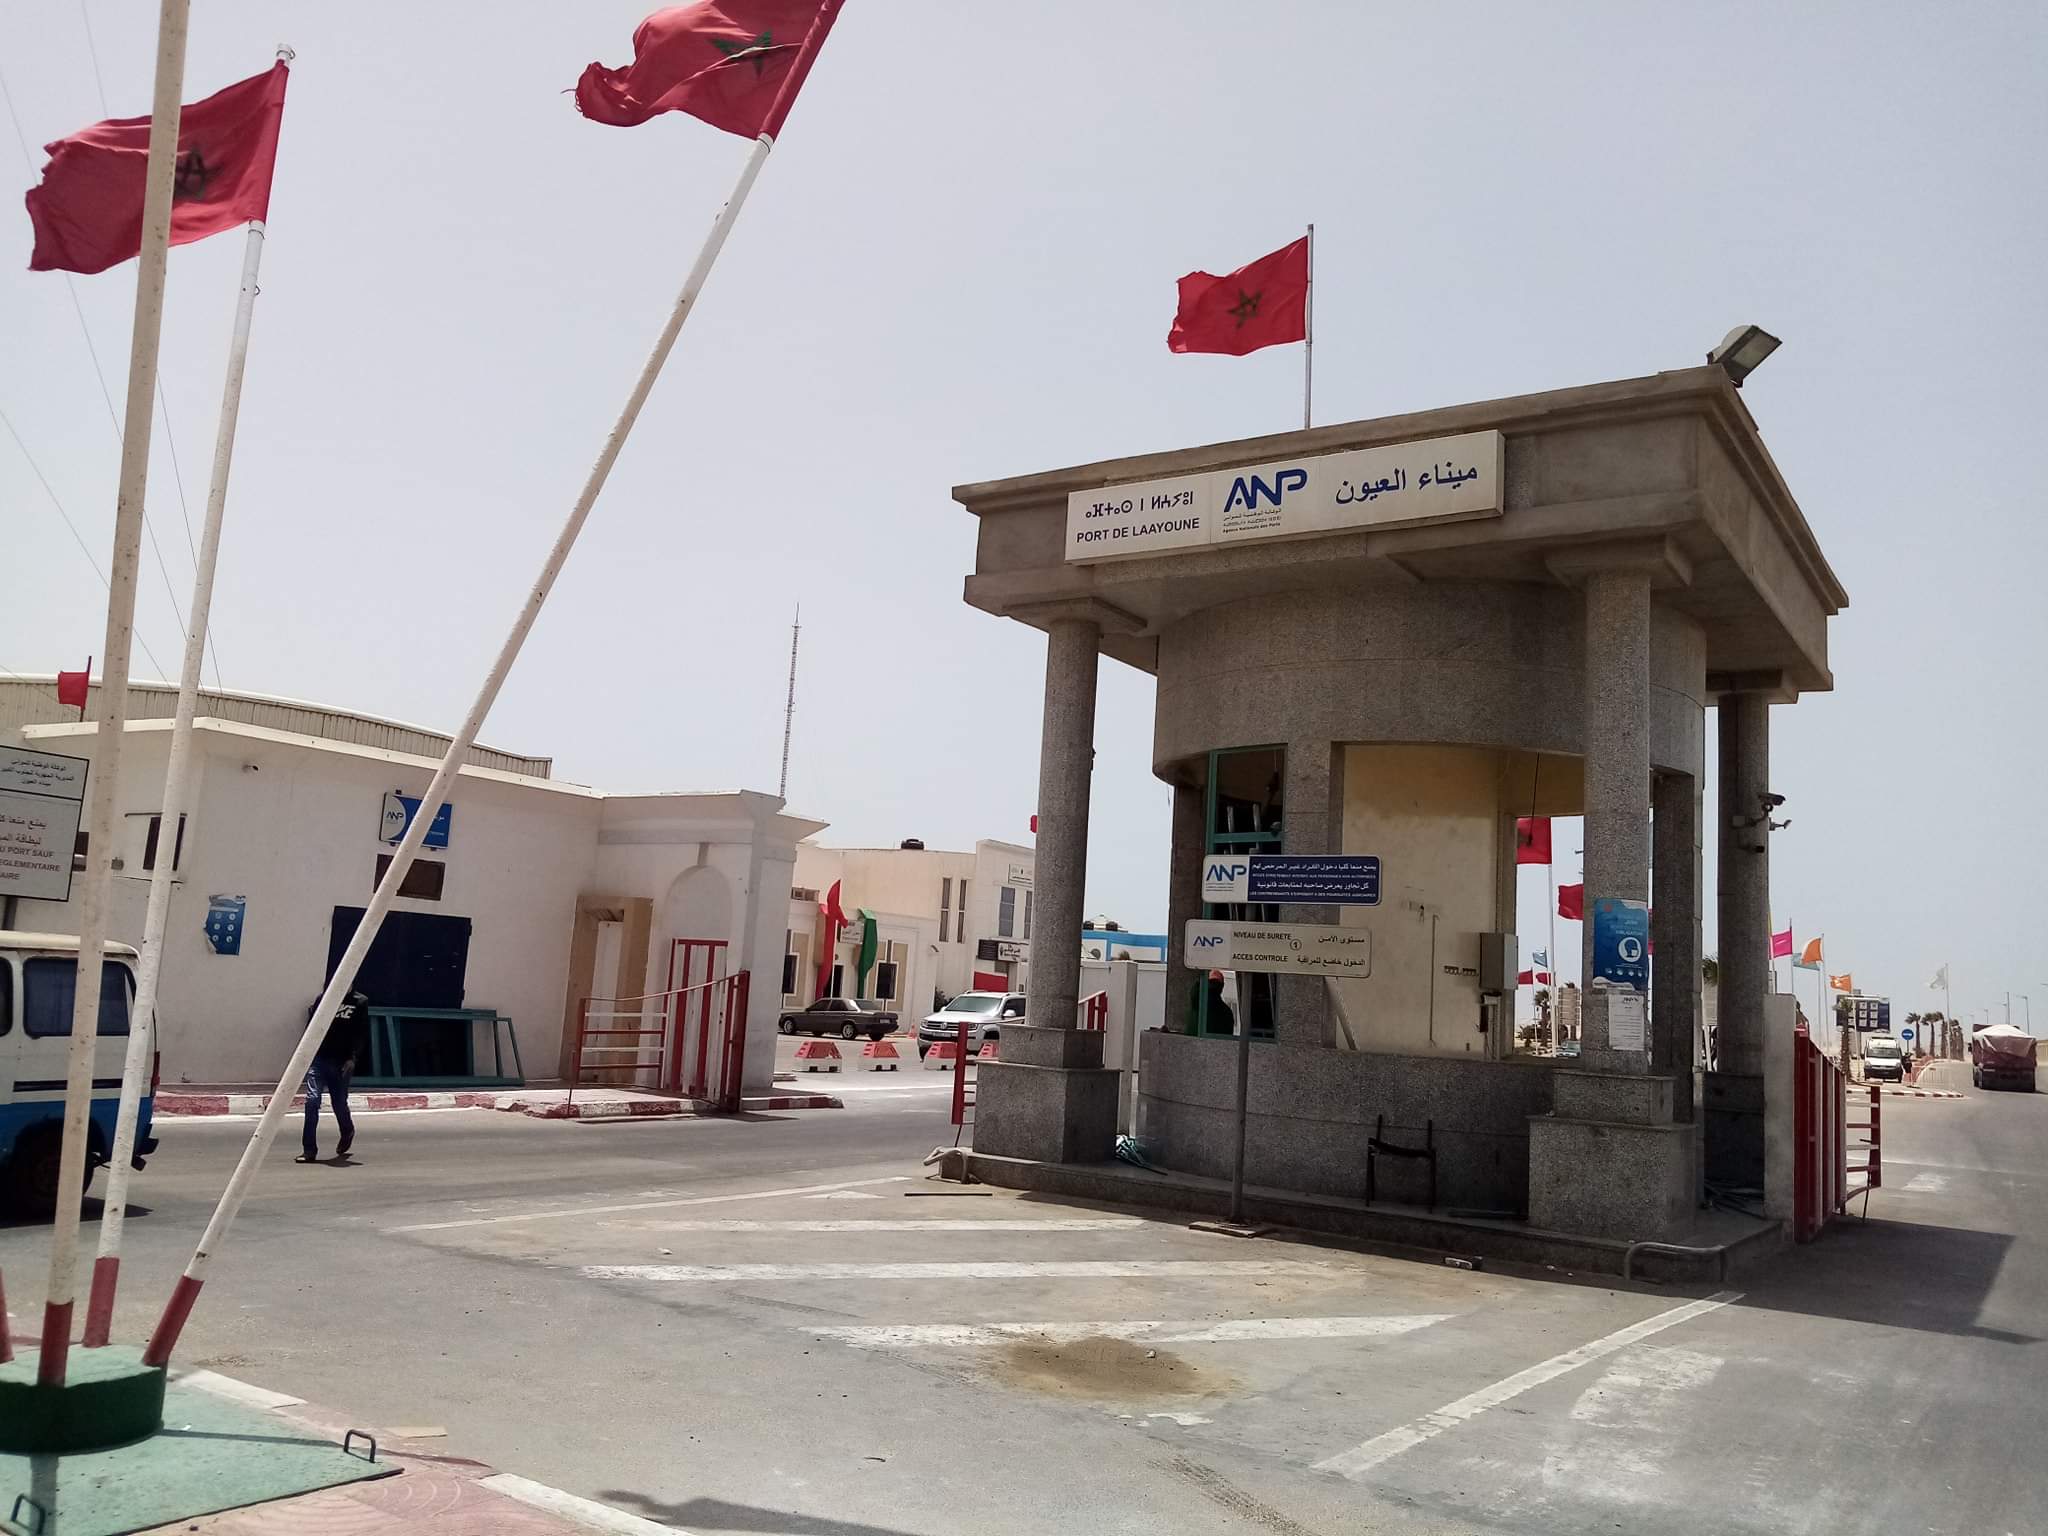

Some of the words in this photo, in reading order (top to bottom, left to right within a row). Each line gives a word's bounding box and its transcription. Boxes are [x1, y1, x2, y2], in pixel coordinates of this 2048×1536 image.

[1418, 461, 1478, 490] ميناء
[1223, 468, 1308, 513] ANP
[1335, 468, 1407, 504] العيون
[1076, 529, 1109, 543] PORT
[1112, 527, 1129, 539] DE
[1132, 518, 1200, 537] LAAYOUNE
[8, 846, 31, 855] PORT
[32, 849, 54, 858] SAUF
[1206, 864, 1247, 882] ANP
[1193, 935, 1224, 948] ANP
[1233, 931, 1257, 940] NIVEAU
[1257, 932, 1266, 940] DE
[1232, 953, 1253, 961] ACCES
[1254, 954, 1289, 963] CONTROLE
